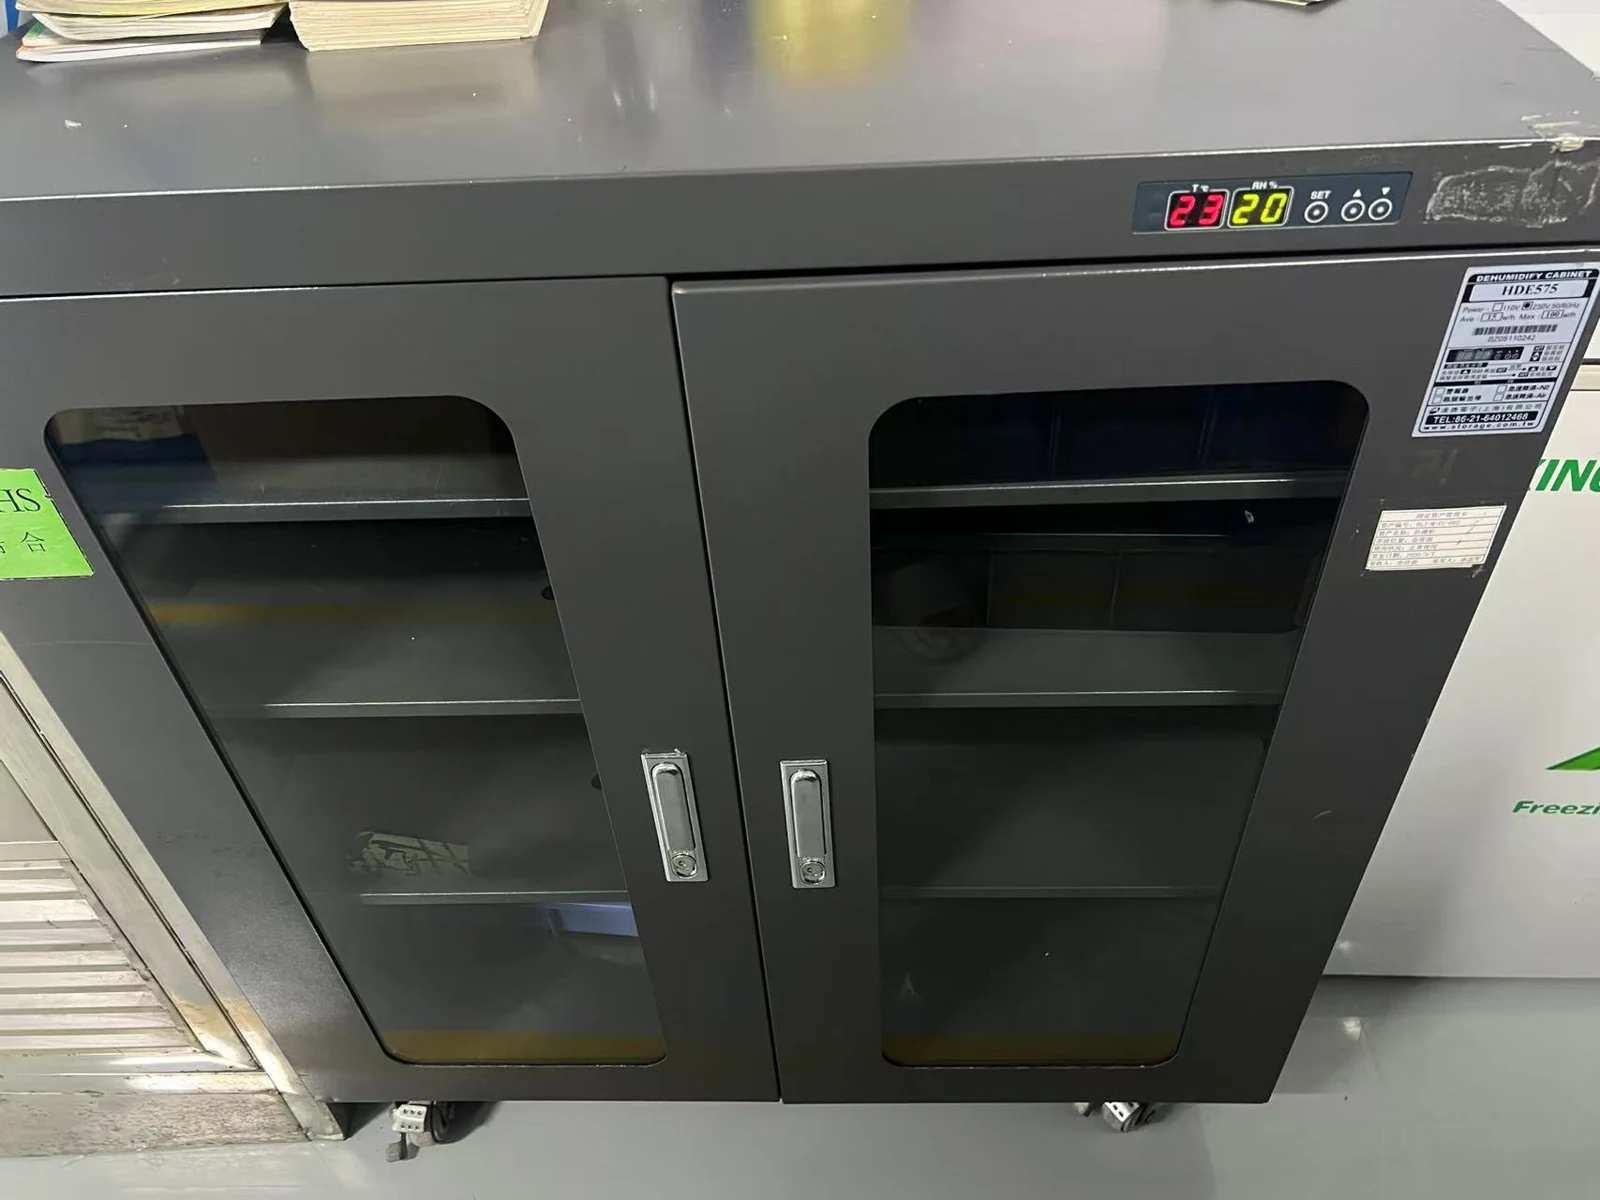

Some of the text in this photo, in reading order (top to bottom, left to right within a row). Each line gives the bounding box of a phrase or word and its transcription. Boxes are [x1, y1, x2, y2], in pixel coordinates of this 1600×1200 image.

[1252, 181, 1267, 190] RH
[1310, 190, 1331, 200] SET
[1169, 194, 1224, 226] 23
[1232, 193, 1288, 224] 20
[1476, 270, 1592, 282] DEHUMIDIFY CABINET
[1502, 283, 1559, 296] HDE575
[1433, 412, 1529, 424] TEL:86-21-64012468
[1528, 458, 1600, 492] IN
